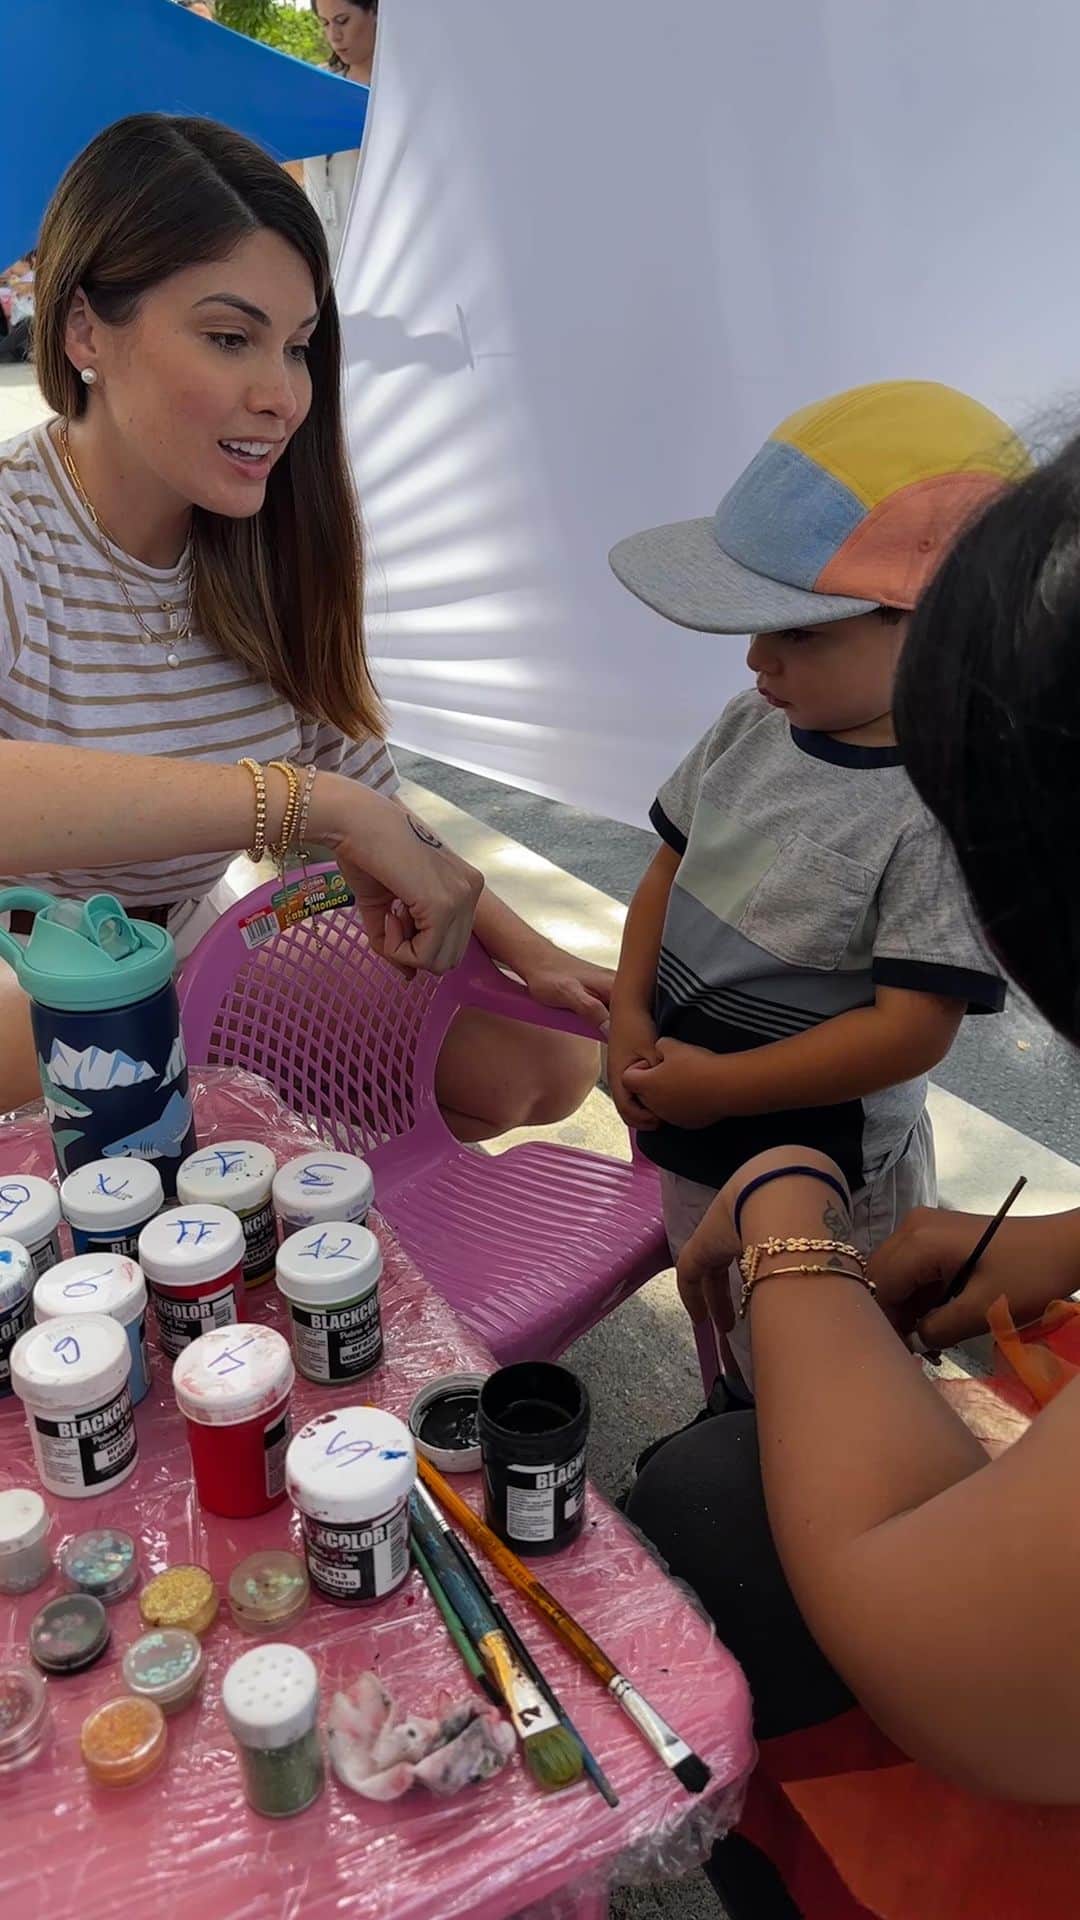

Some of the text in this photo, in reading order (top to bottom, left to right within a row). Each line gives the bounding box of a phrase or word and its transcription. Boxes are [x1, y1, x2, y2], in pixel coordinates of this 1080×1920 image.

[304, 891, 326, 906] Silla
[312, 894, 348, 915] Monaco
[298, 1231, 361, 1260] 12
